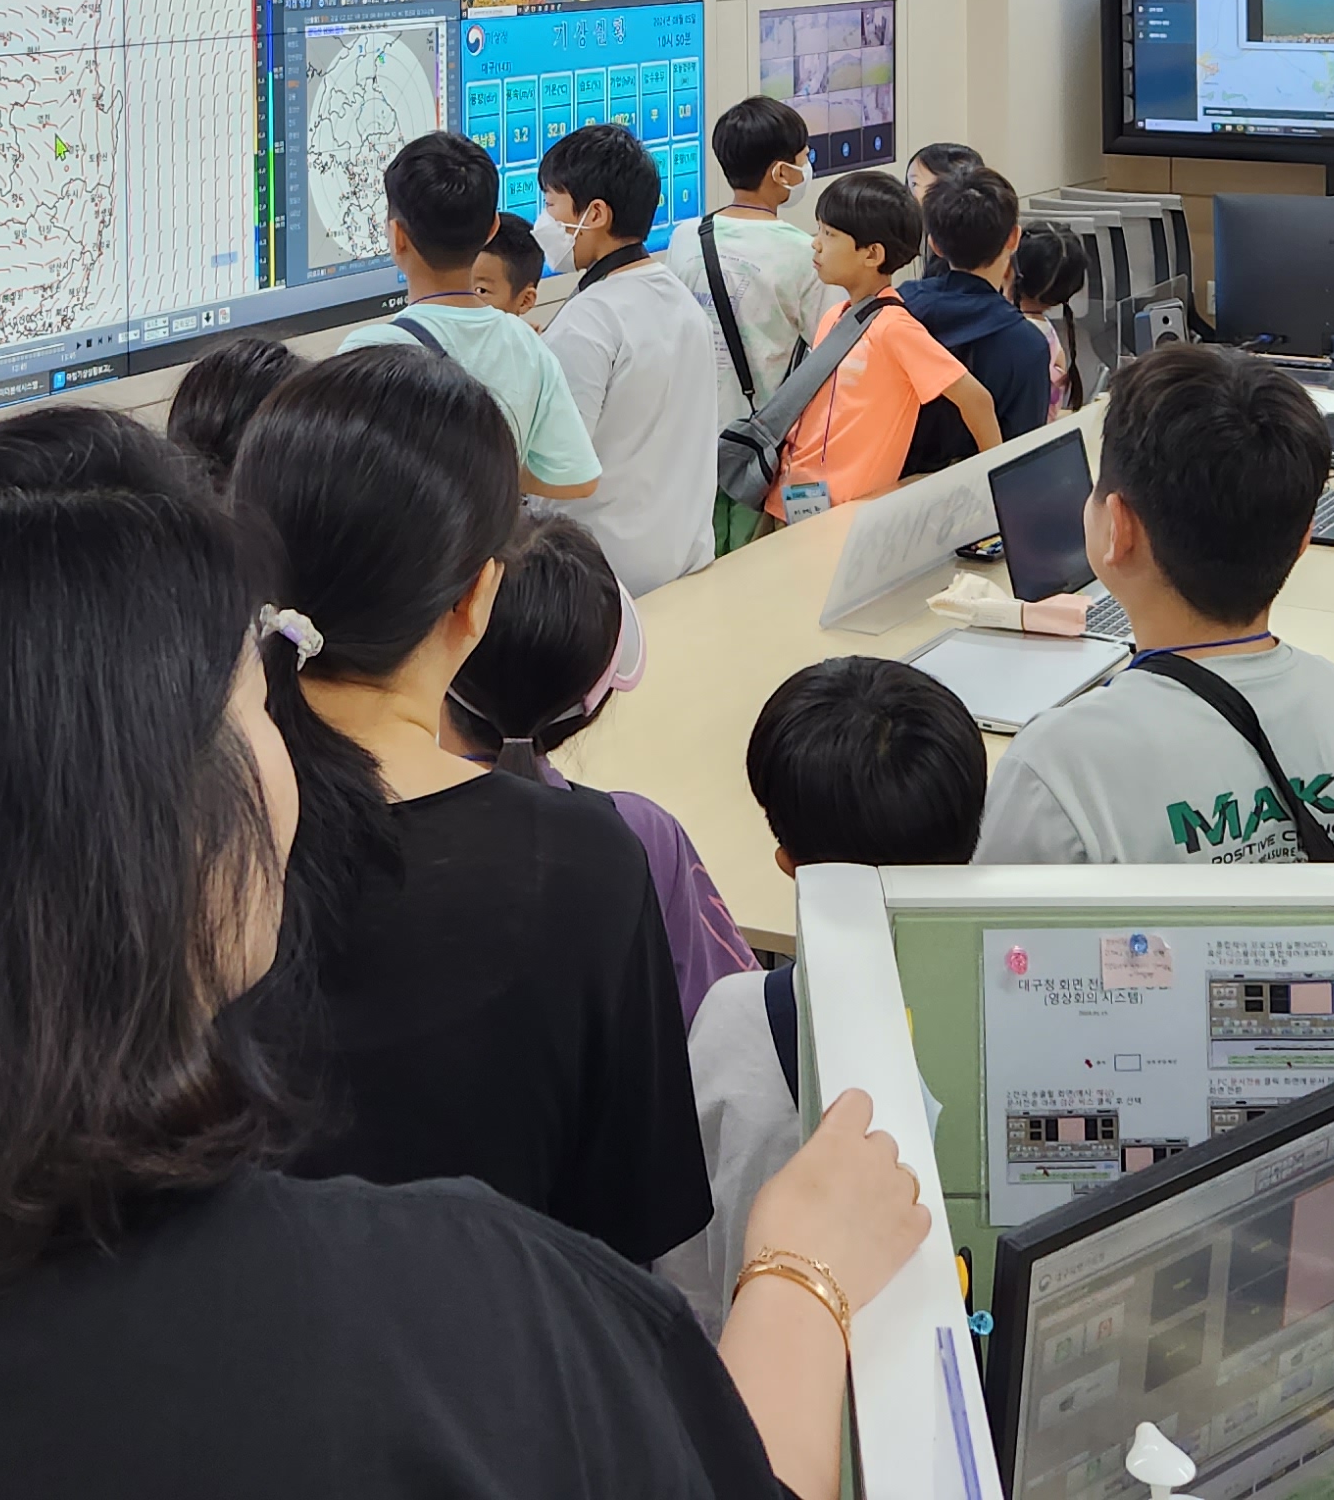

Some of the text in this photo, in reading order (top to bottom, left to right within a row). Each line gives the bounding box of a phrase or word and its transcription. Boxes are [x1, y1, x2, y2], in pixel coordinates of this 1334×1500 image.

[485, 31, 509, 45] 기상청
[657, 32, 692, 48] 10시 50분
[480, 61, 512, 74] 대구(143)
[506, 88, 536, 101] 풍속(m/s)
[513, 126, 529, 143] 3.2
[547, 122, 566, 138] 32.0
[1211, 833, 1276, 864] POSITIVE
[1018, 977, 1084, 992] 대구청 화면
[1043, 992, 1144, 1006] (영상회의 시스템)
